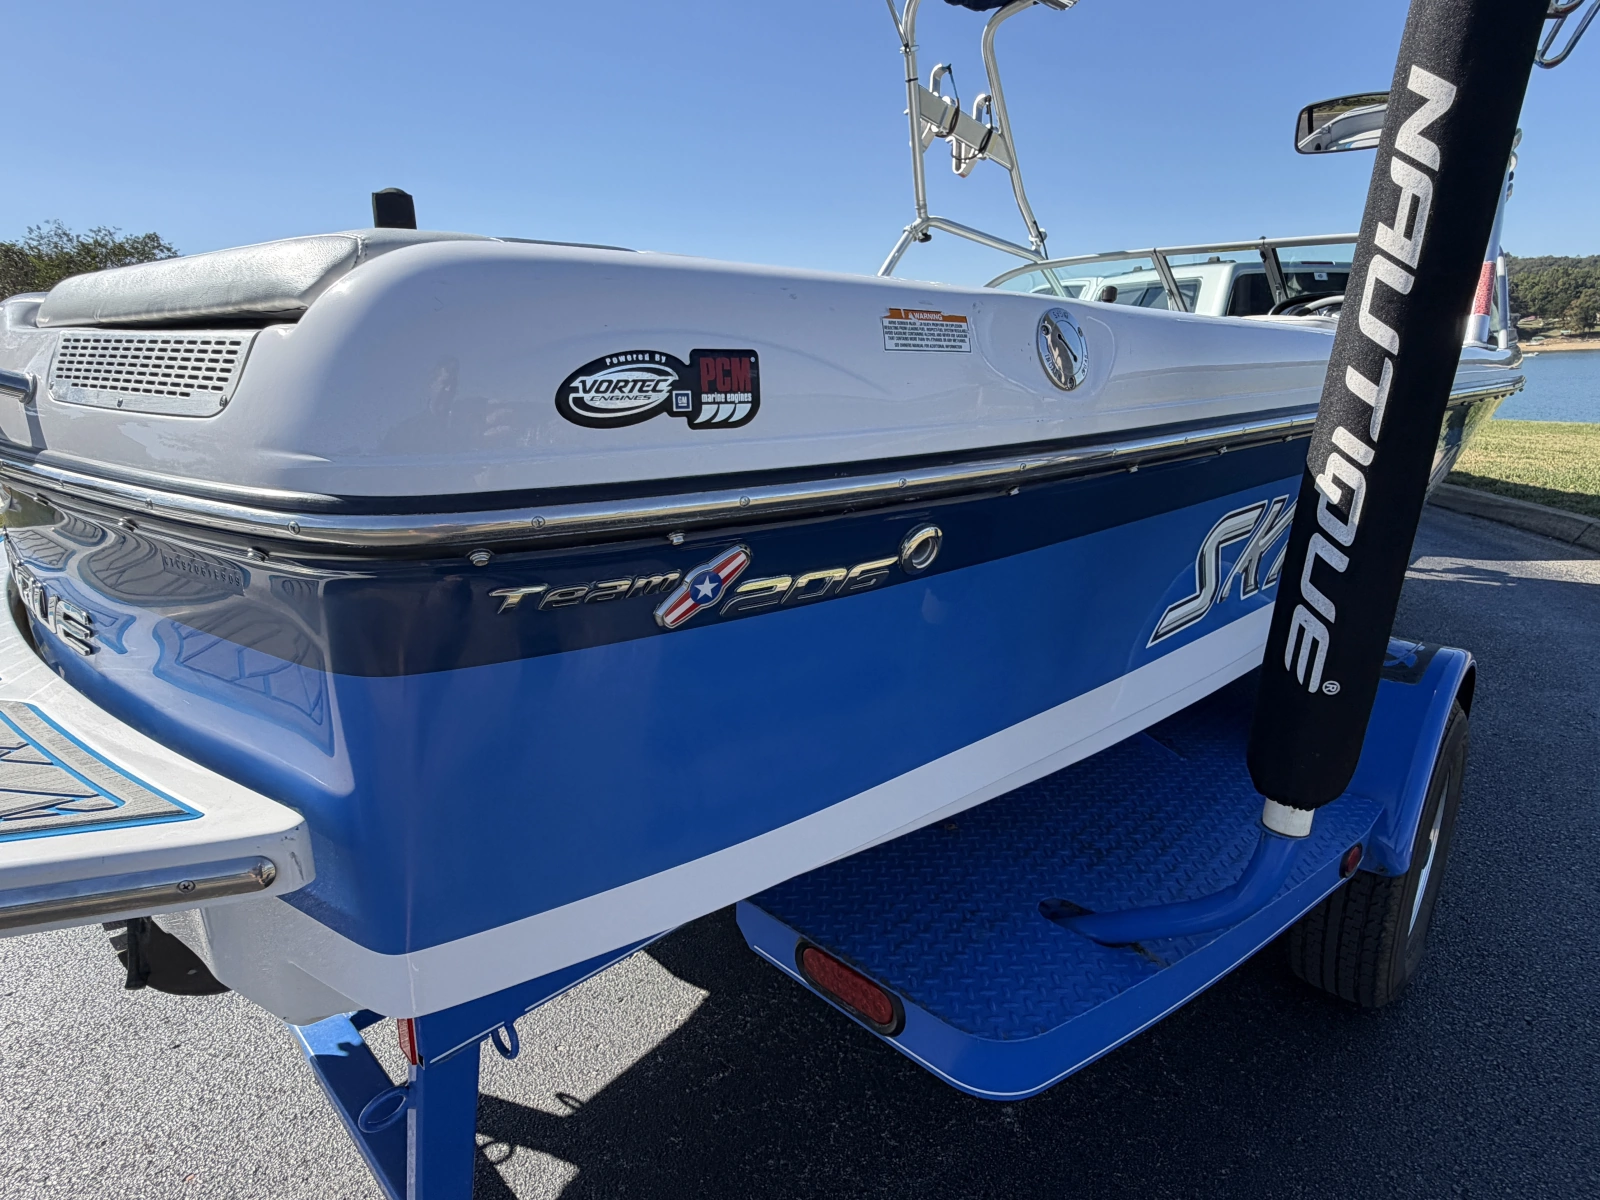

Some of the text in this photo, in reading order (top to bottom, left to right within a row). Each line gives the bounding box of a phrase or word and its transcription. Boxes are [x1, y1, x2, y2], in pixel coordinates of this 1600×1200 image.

[914, 312, 943, 321] WARNING
[605, 353, 667, 366] Powered By
[700, 356, 752, 393] PCM
[1284, 63, 1458, 694] NAUTIQUE
[579, 378, 670, 395] VORTEC
[588, 394, 653, 402] ENGINES
[677, 395, 688, 406] GM
[701, 391, 752, 404] marine engines
[720, 555, 898, 617] 206
